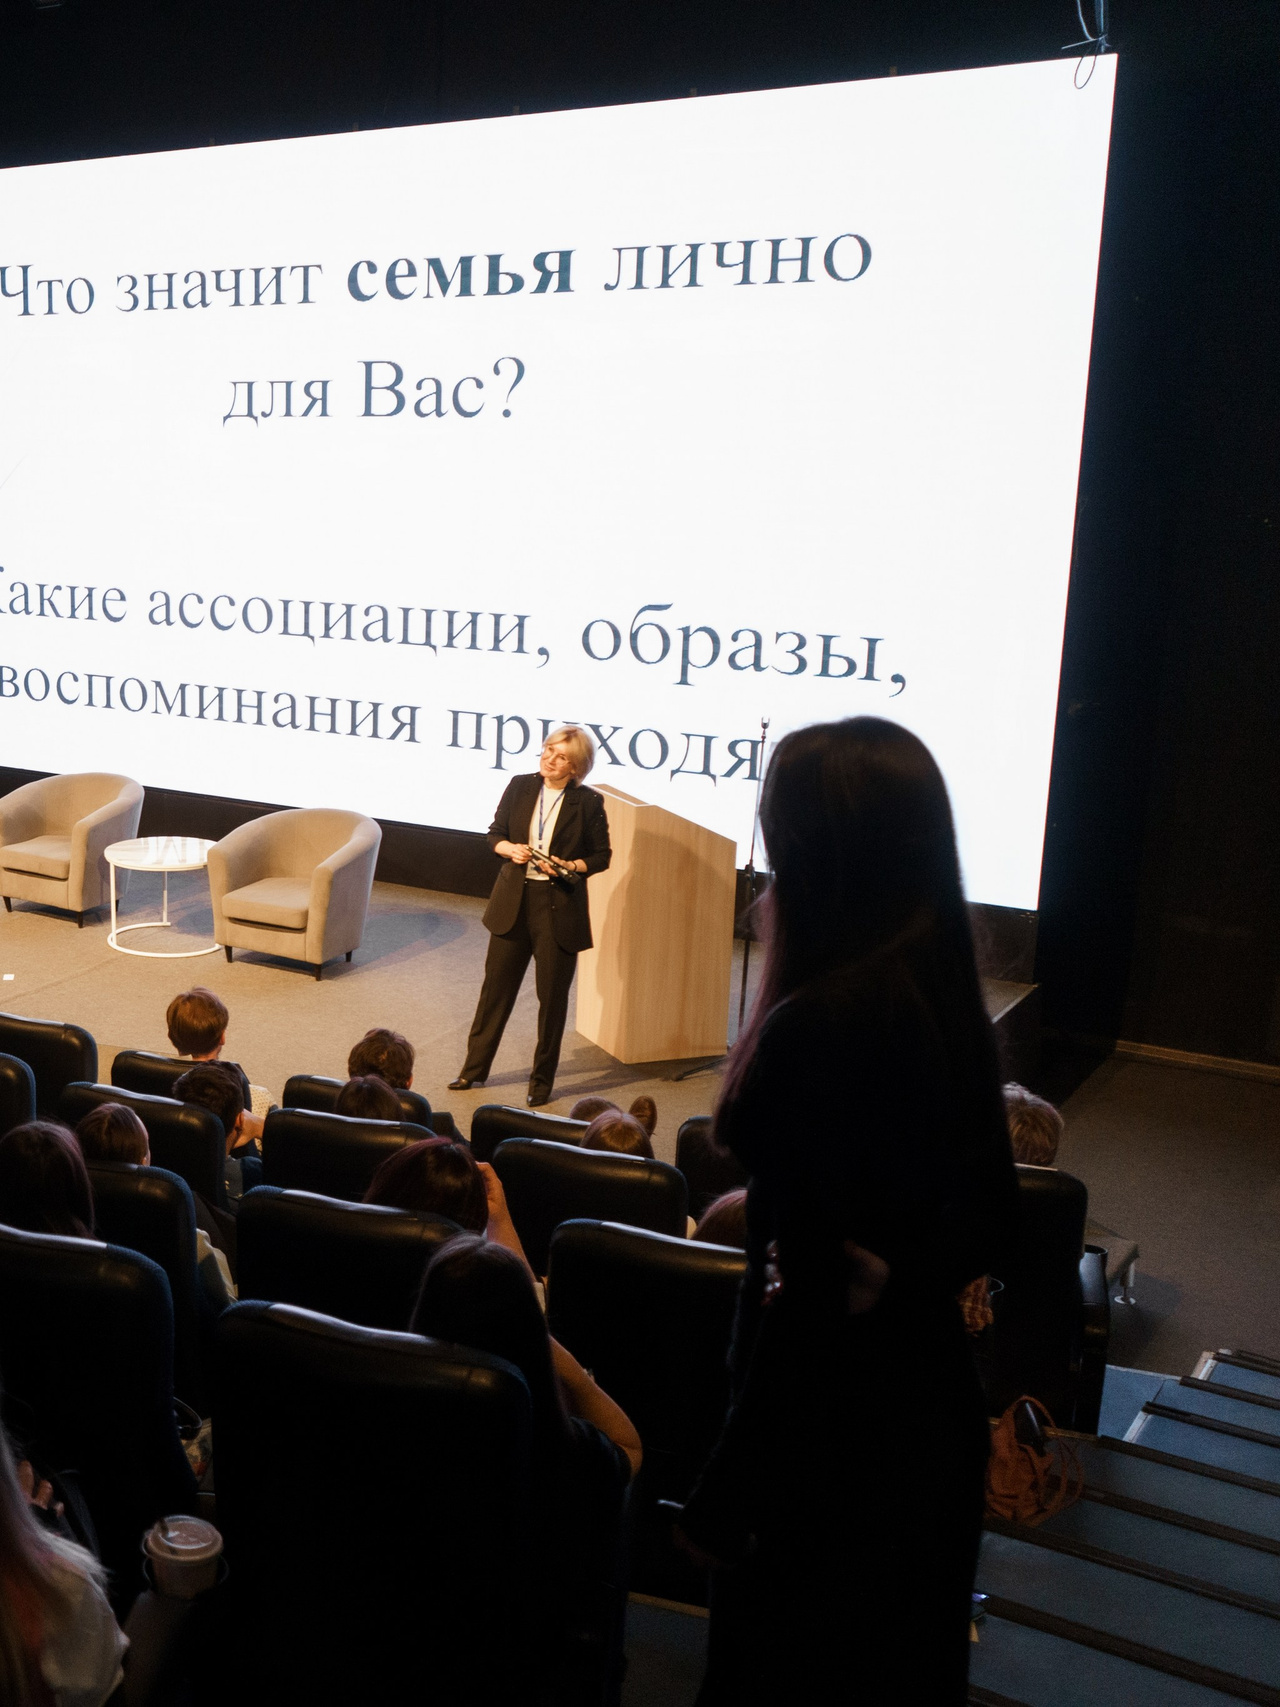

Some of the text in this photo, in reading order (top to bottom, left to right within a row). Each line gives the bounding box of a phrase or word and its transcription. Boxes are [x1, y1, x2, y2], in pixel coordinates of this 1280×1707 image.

[116, 264, 323, 313] значит
[347, 249, 576, 303] семья
[603, 233, 873, 292] лично
[222, 356, 526, 428] для Вас?
[148, 590, 550, 669] ассоциации,
[581, 602, 907, 698] образы,
[446, 709, 777, 787] прходя
